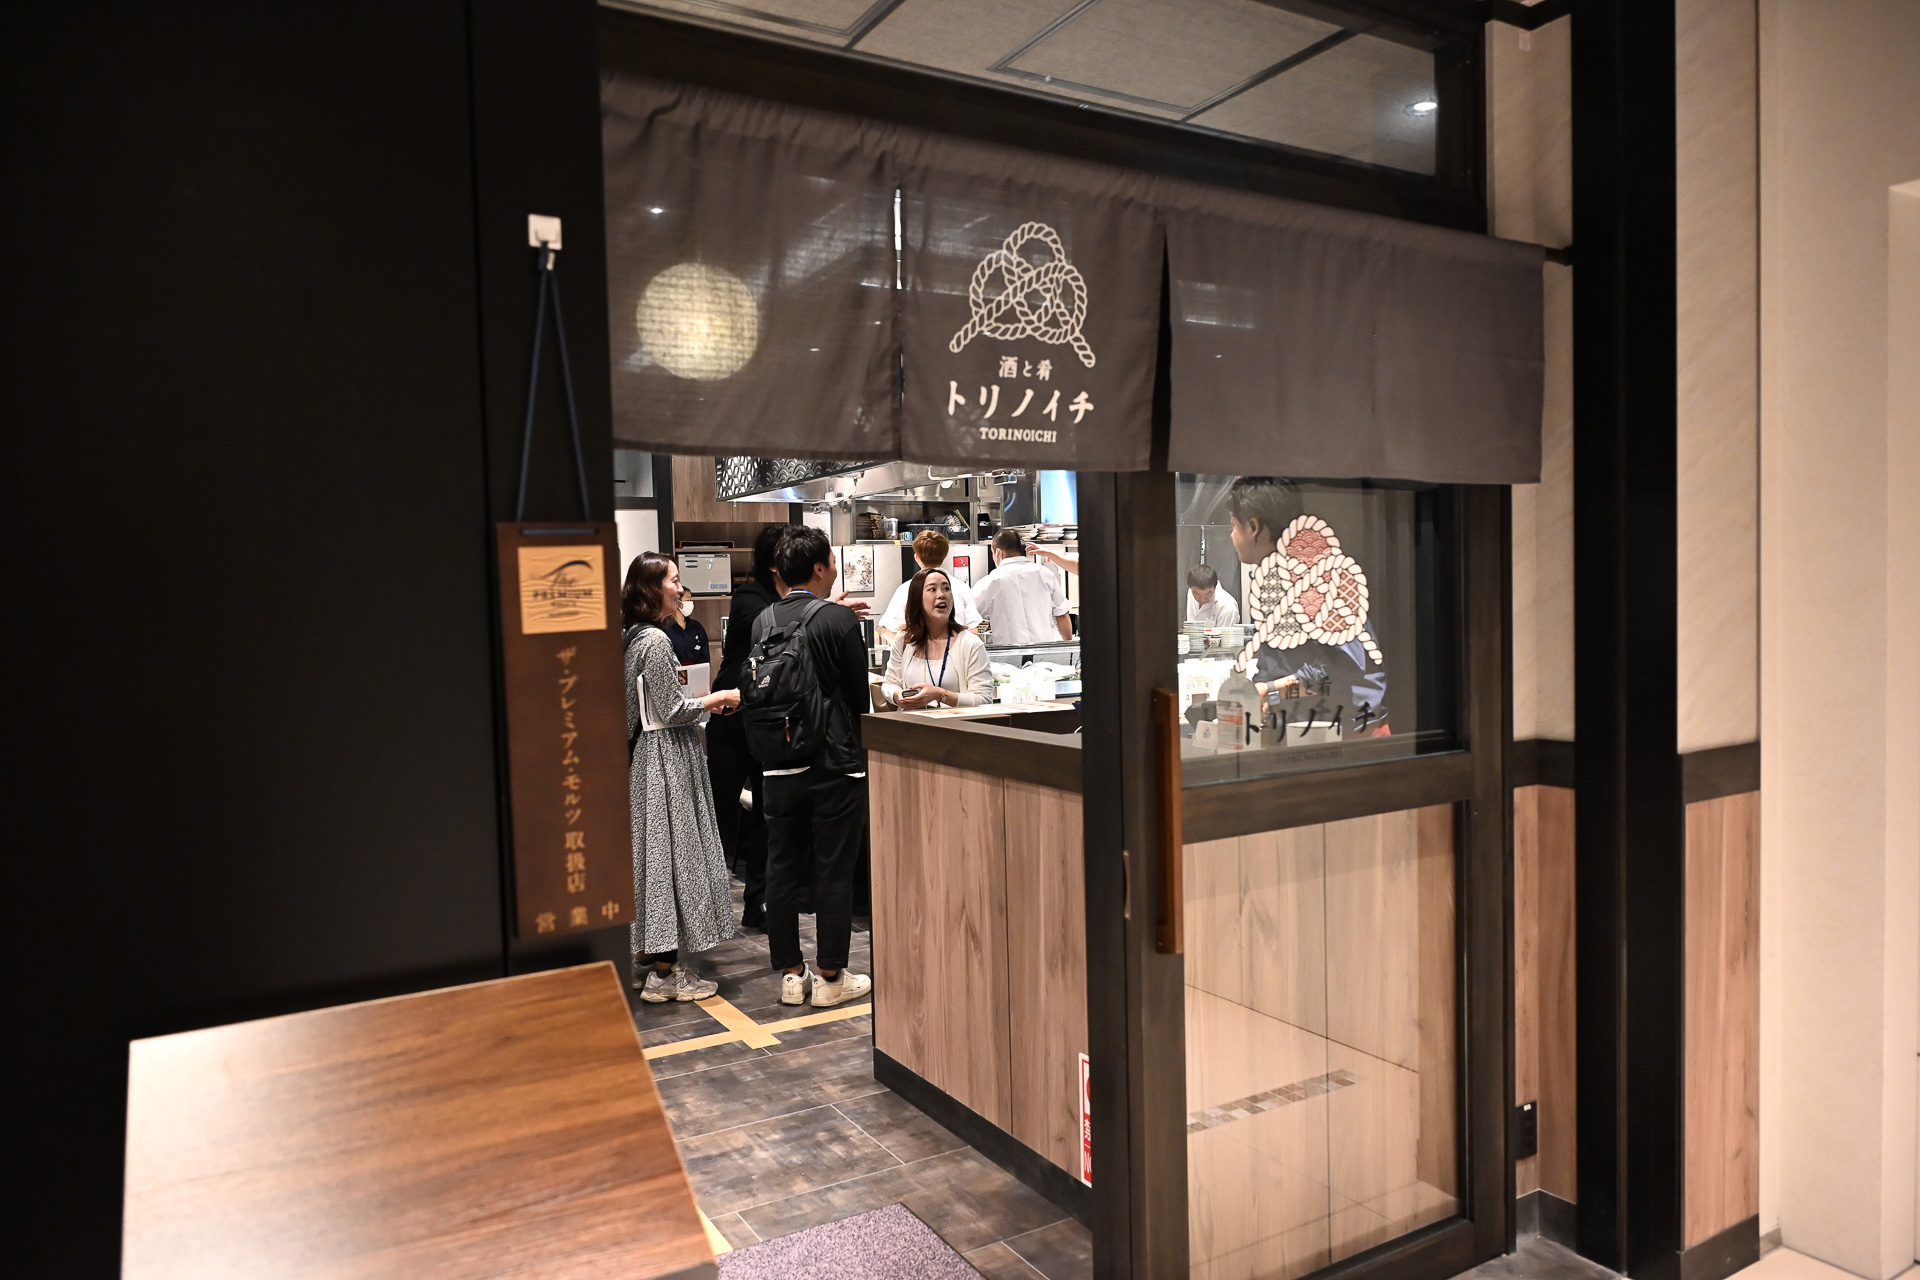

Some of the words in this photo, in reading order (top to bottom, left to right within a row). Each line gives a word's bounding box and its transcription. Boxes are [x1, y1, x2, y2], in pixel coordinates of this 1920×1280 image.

[999, 355, 1052, 381] 酒と肴
[948, 380, 1094, 424] トリノイチ
[979, 427, 1057, 443] TORINOICHI
[1245, 701, 1376, 746] トリノイチ
